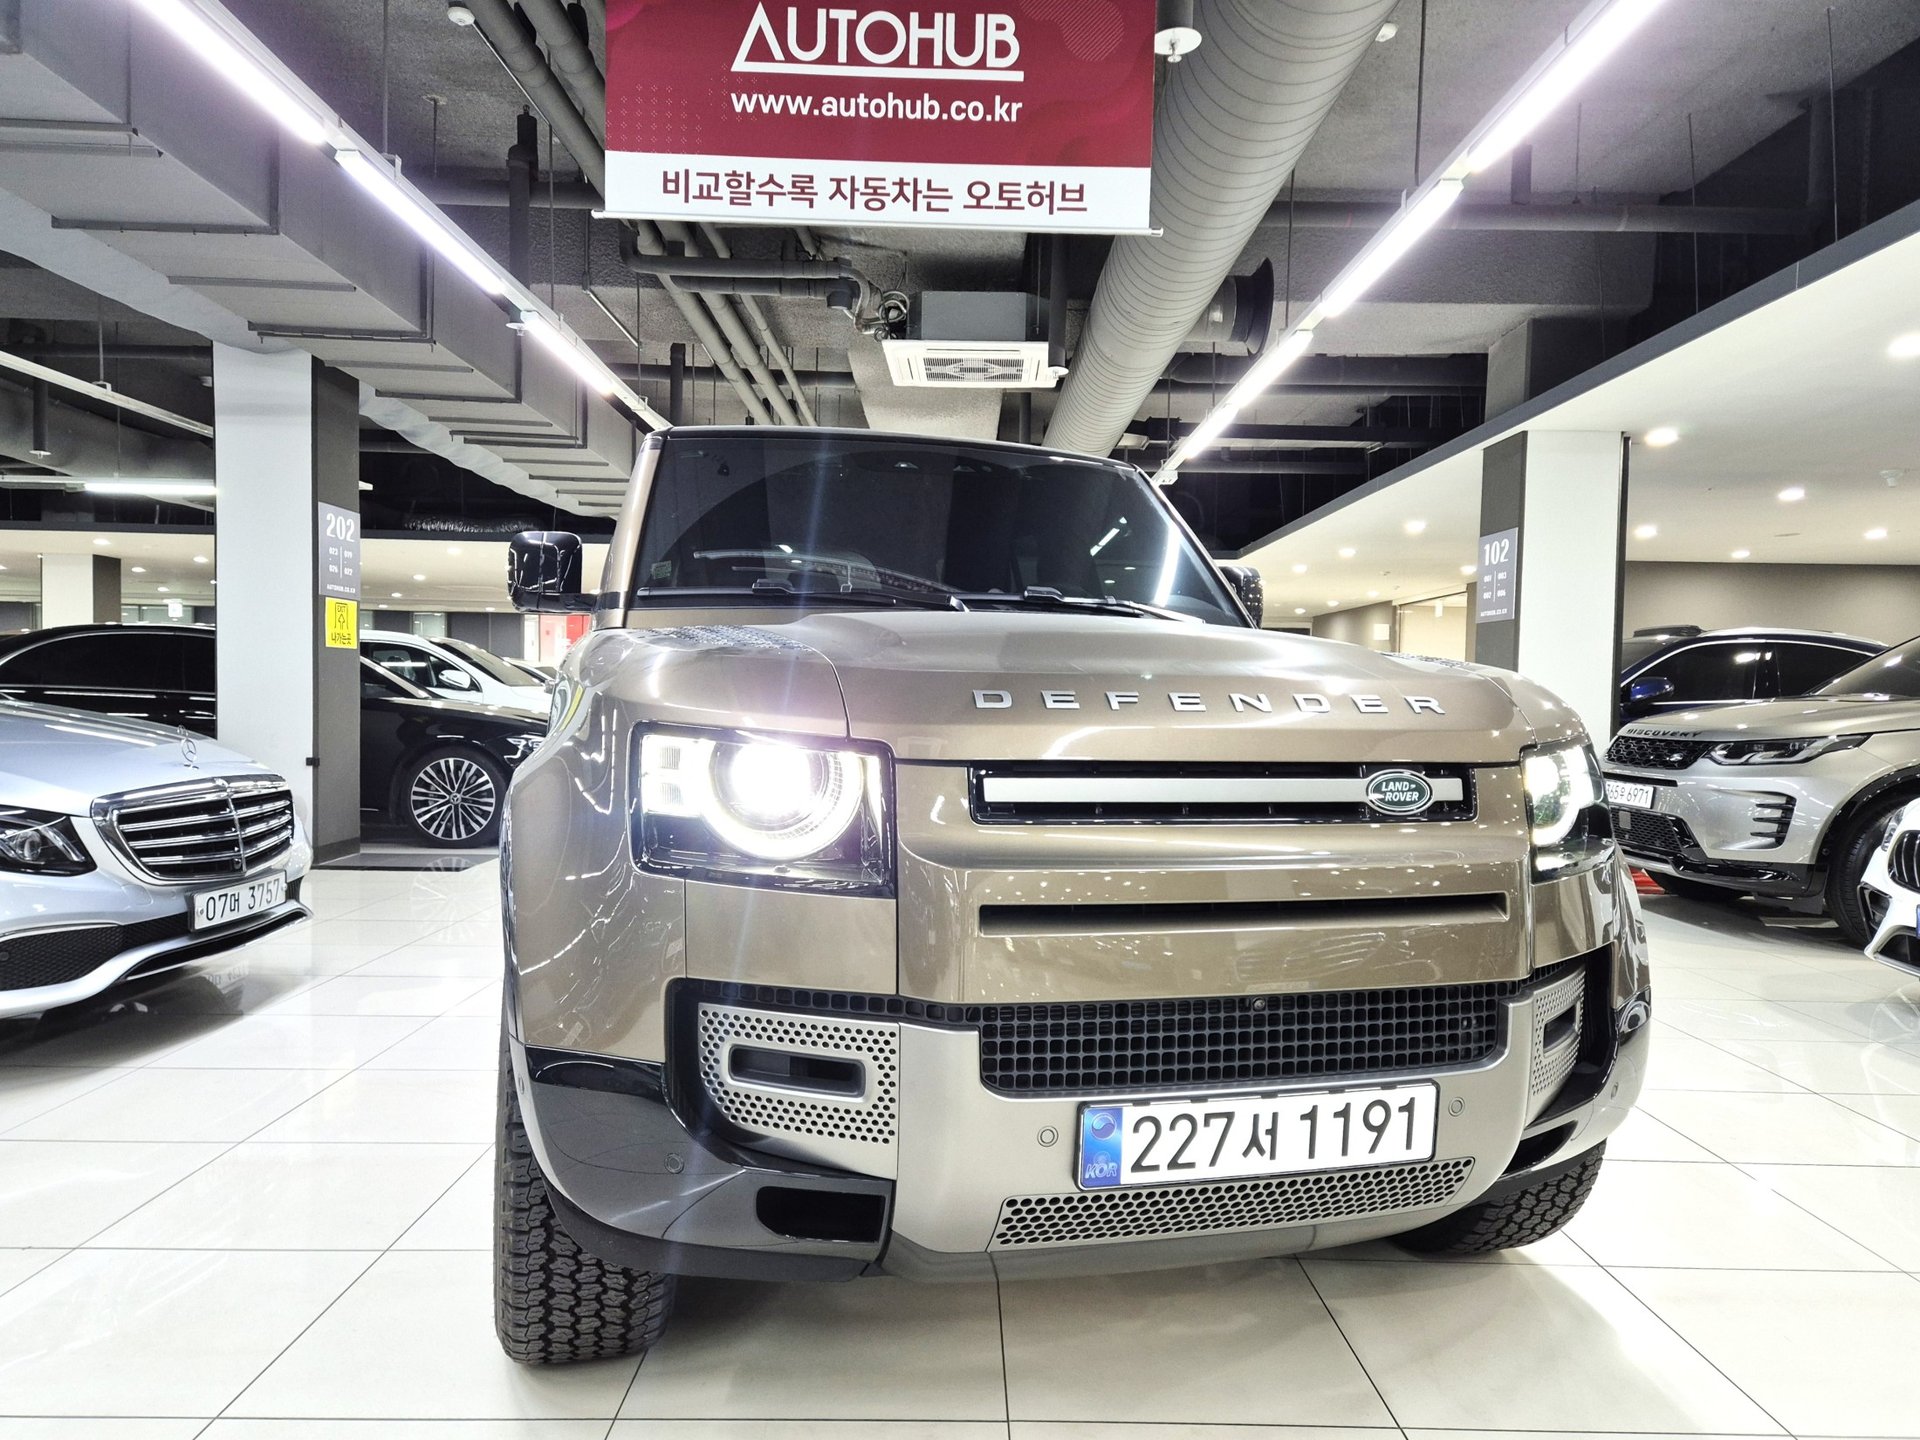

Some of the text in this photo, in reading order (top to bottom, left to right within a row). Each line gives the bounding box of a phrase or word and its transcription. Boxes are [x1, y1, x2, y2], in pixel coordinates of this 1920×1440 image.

[731, 1, 1024, 81] AUTOHUB
[730, 90, 1023, 123] www.autohub.co.kr
[661, 168, 1089, 216] 비교할수록 자동차는 오토허브
[326, 512, 355, 543] 202
[1484, 538, 1510, 567] 102
[973, 688, 1447, 715] DEFENDER
[1381, 781, 1409, 792] LAND
[1385, 791, 1419, 802] ROVER
[1627, 785, 1649, 806] 6971
[206, 878, 280, 922] 07머 3757
[1130, 1096, 1416, 1173] 227서 1191
[1084, 1161, 1118, 1179] KOR
